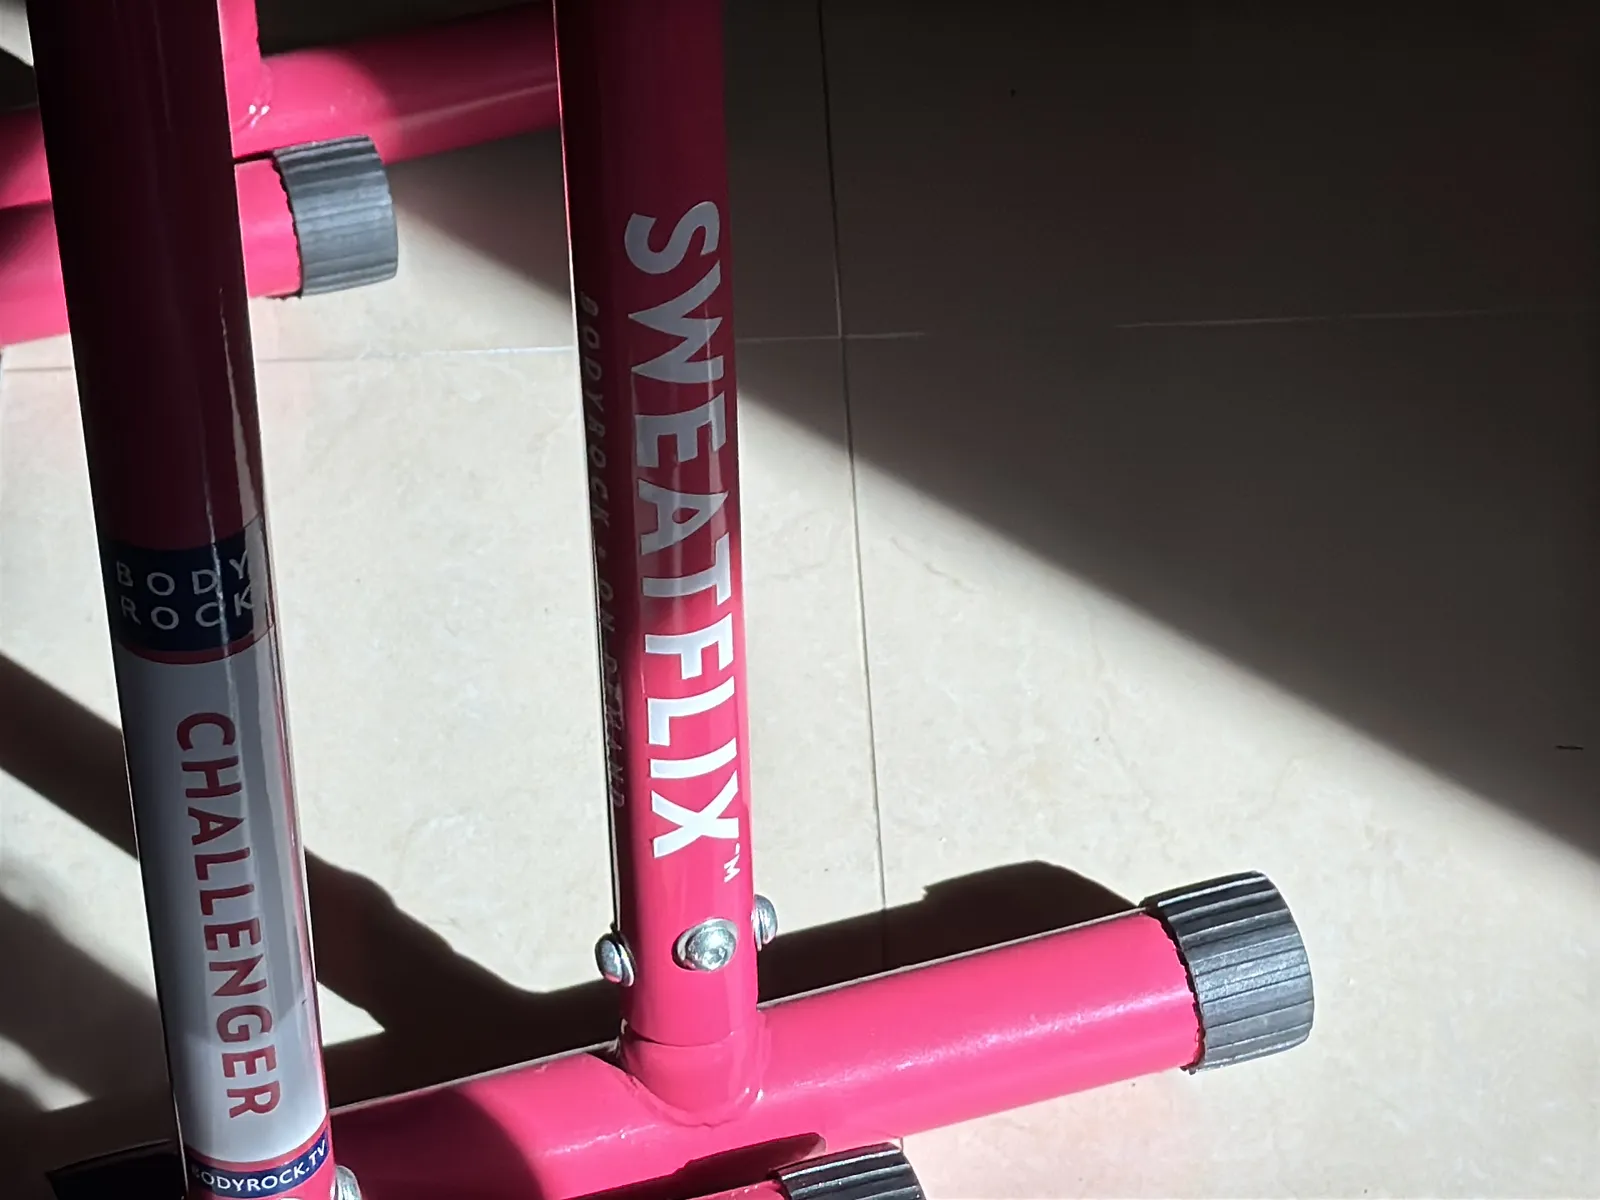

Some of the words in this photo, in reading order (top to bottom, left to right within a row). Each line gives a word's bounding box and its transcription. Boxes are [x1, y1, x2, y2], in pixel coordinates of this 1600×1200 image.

[582, 291, 609, 528] BODYROCK
[116, 549, 249, 596] BODY
[120, 584, 254, 631] ROCK
[624, 201, 739, 858] SWEATFLIX
[176, 712, 280, 1118] CHALLENGER
